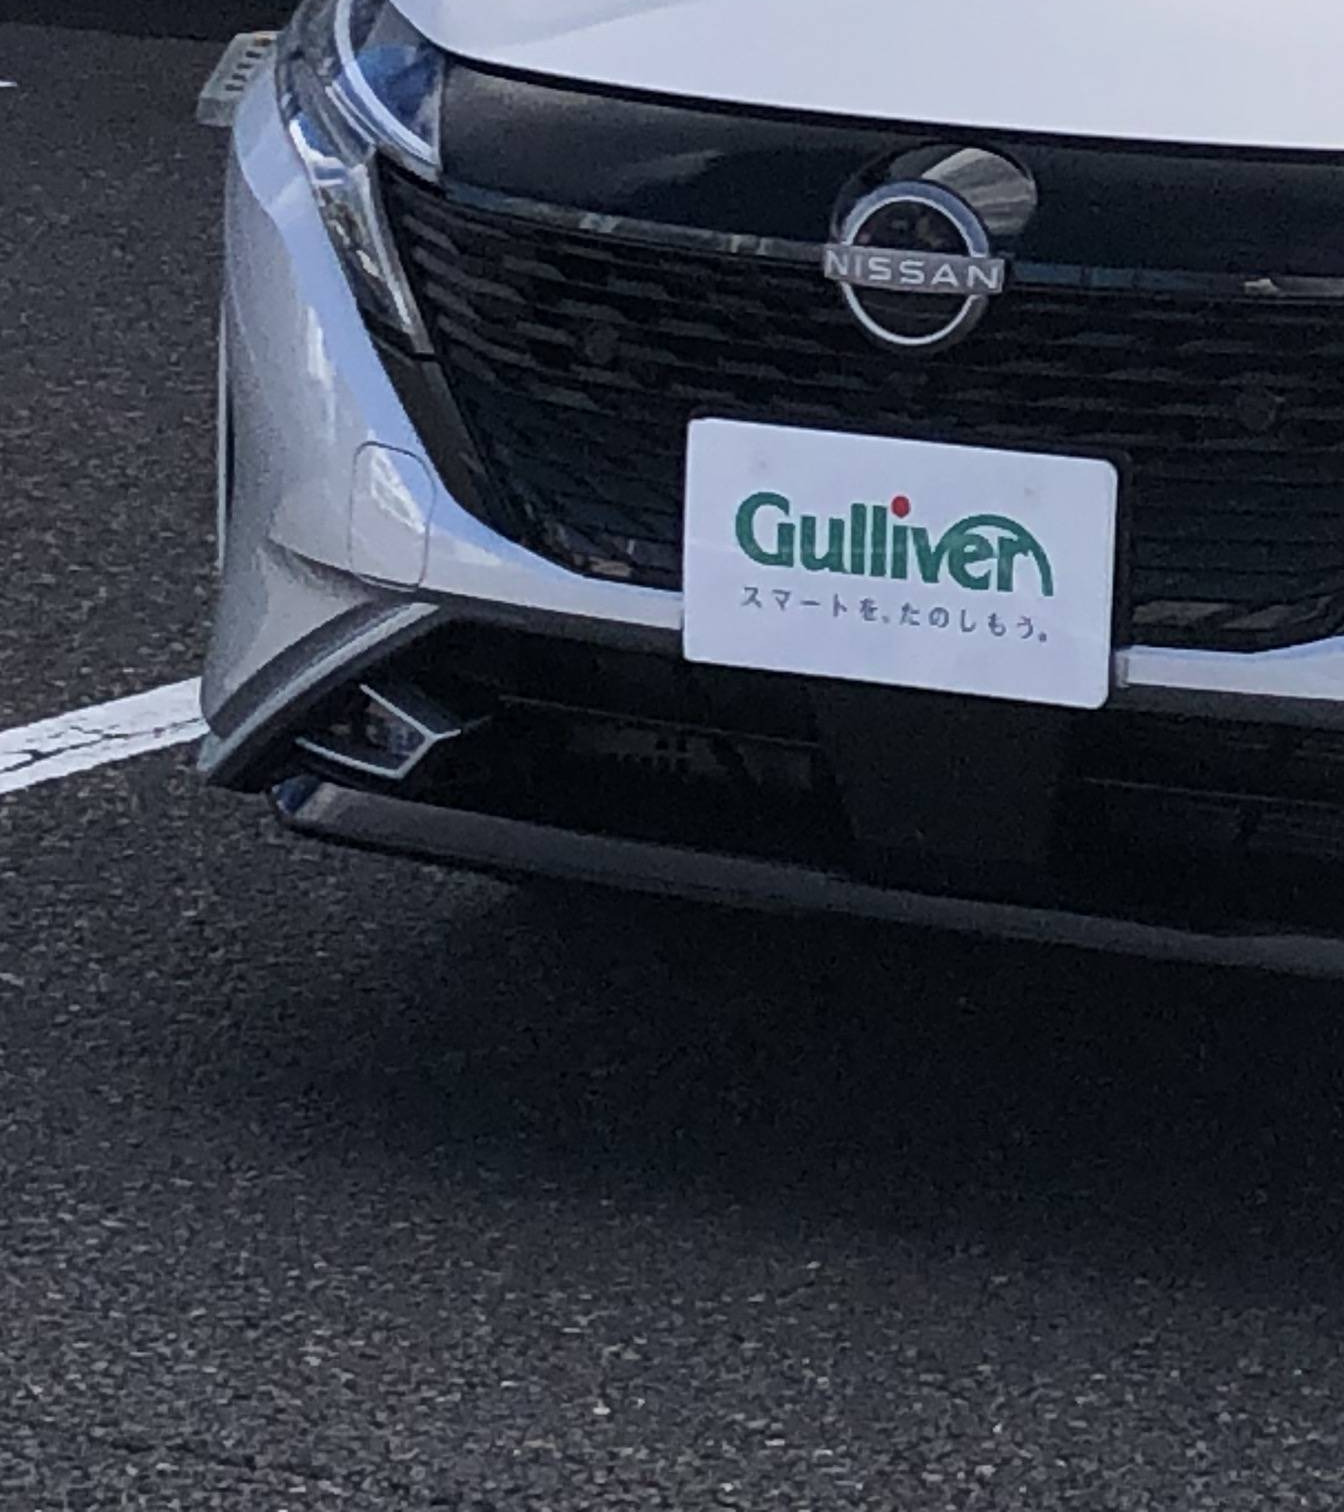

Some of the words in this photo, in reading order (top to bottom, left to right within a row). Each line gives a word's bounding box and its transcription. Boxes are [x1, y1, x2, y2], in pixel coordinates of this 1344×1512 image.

[826, 250, 999, 289] NISSAN
[735, 491, 1054, 596] Gulliver
[741, 586, 1048, 643] スマートを、たのしもう。
